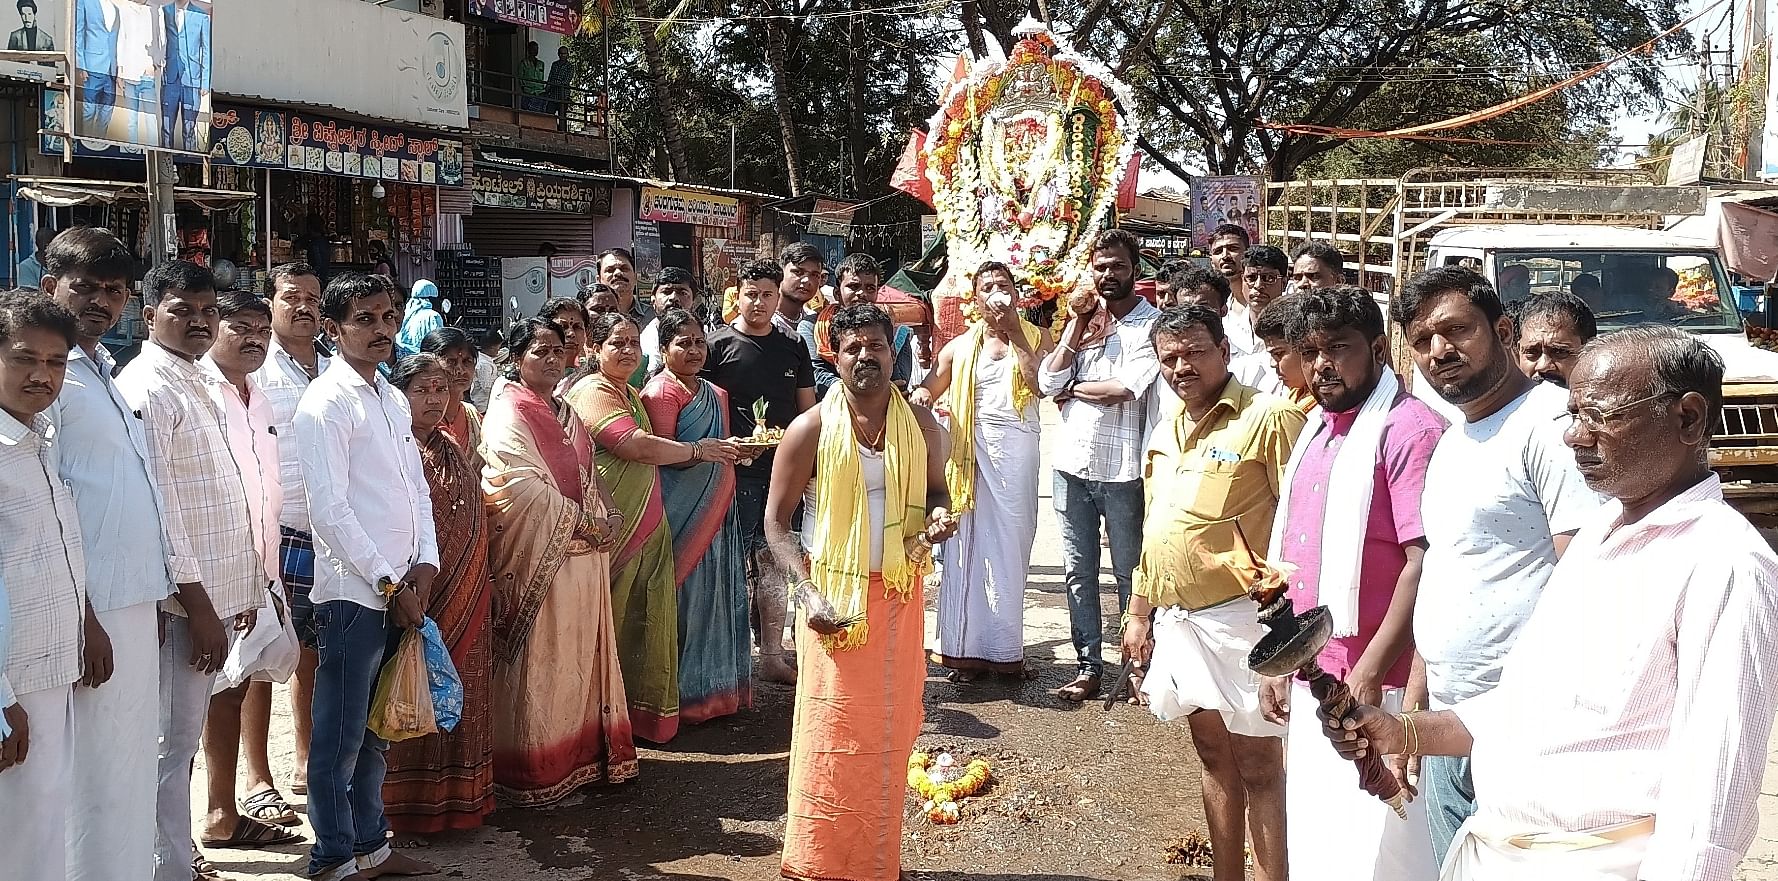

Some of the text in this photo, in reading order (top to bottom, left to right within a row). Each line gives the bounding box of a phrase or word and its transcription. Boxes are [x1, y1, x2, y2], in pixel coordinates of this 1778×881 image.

[290, 116, 309, 145] ಶ್ರೀ
[370, 131, 405, 157] ಸ್ವೀಟ್
[407, 137, 439, 164] ಸ್ಟಾಲ್
[536, 182, 594, 202] ಪ್ರಿಯದರ್ಶಿನಿ
